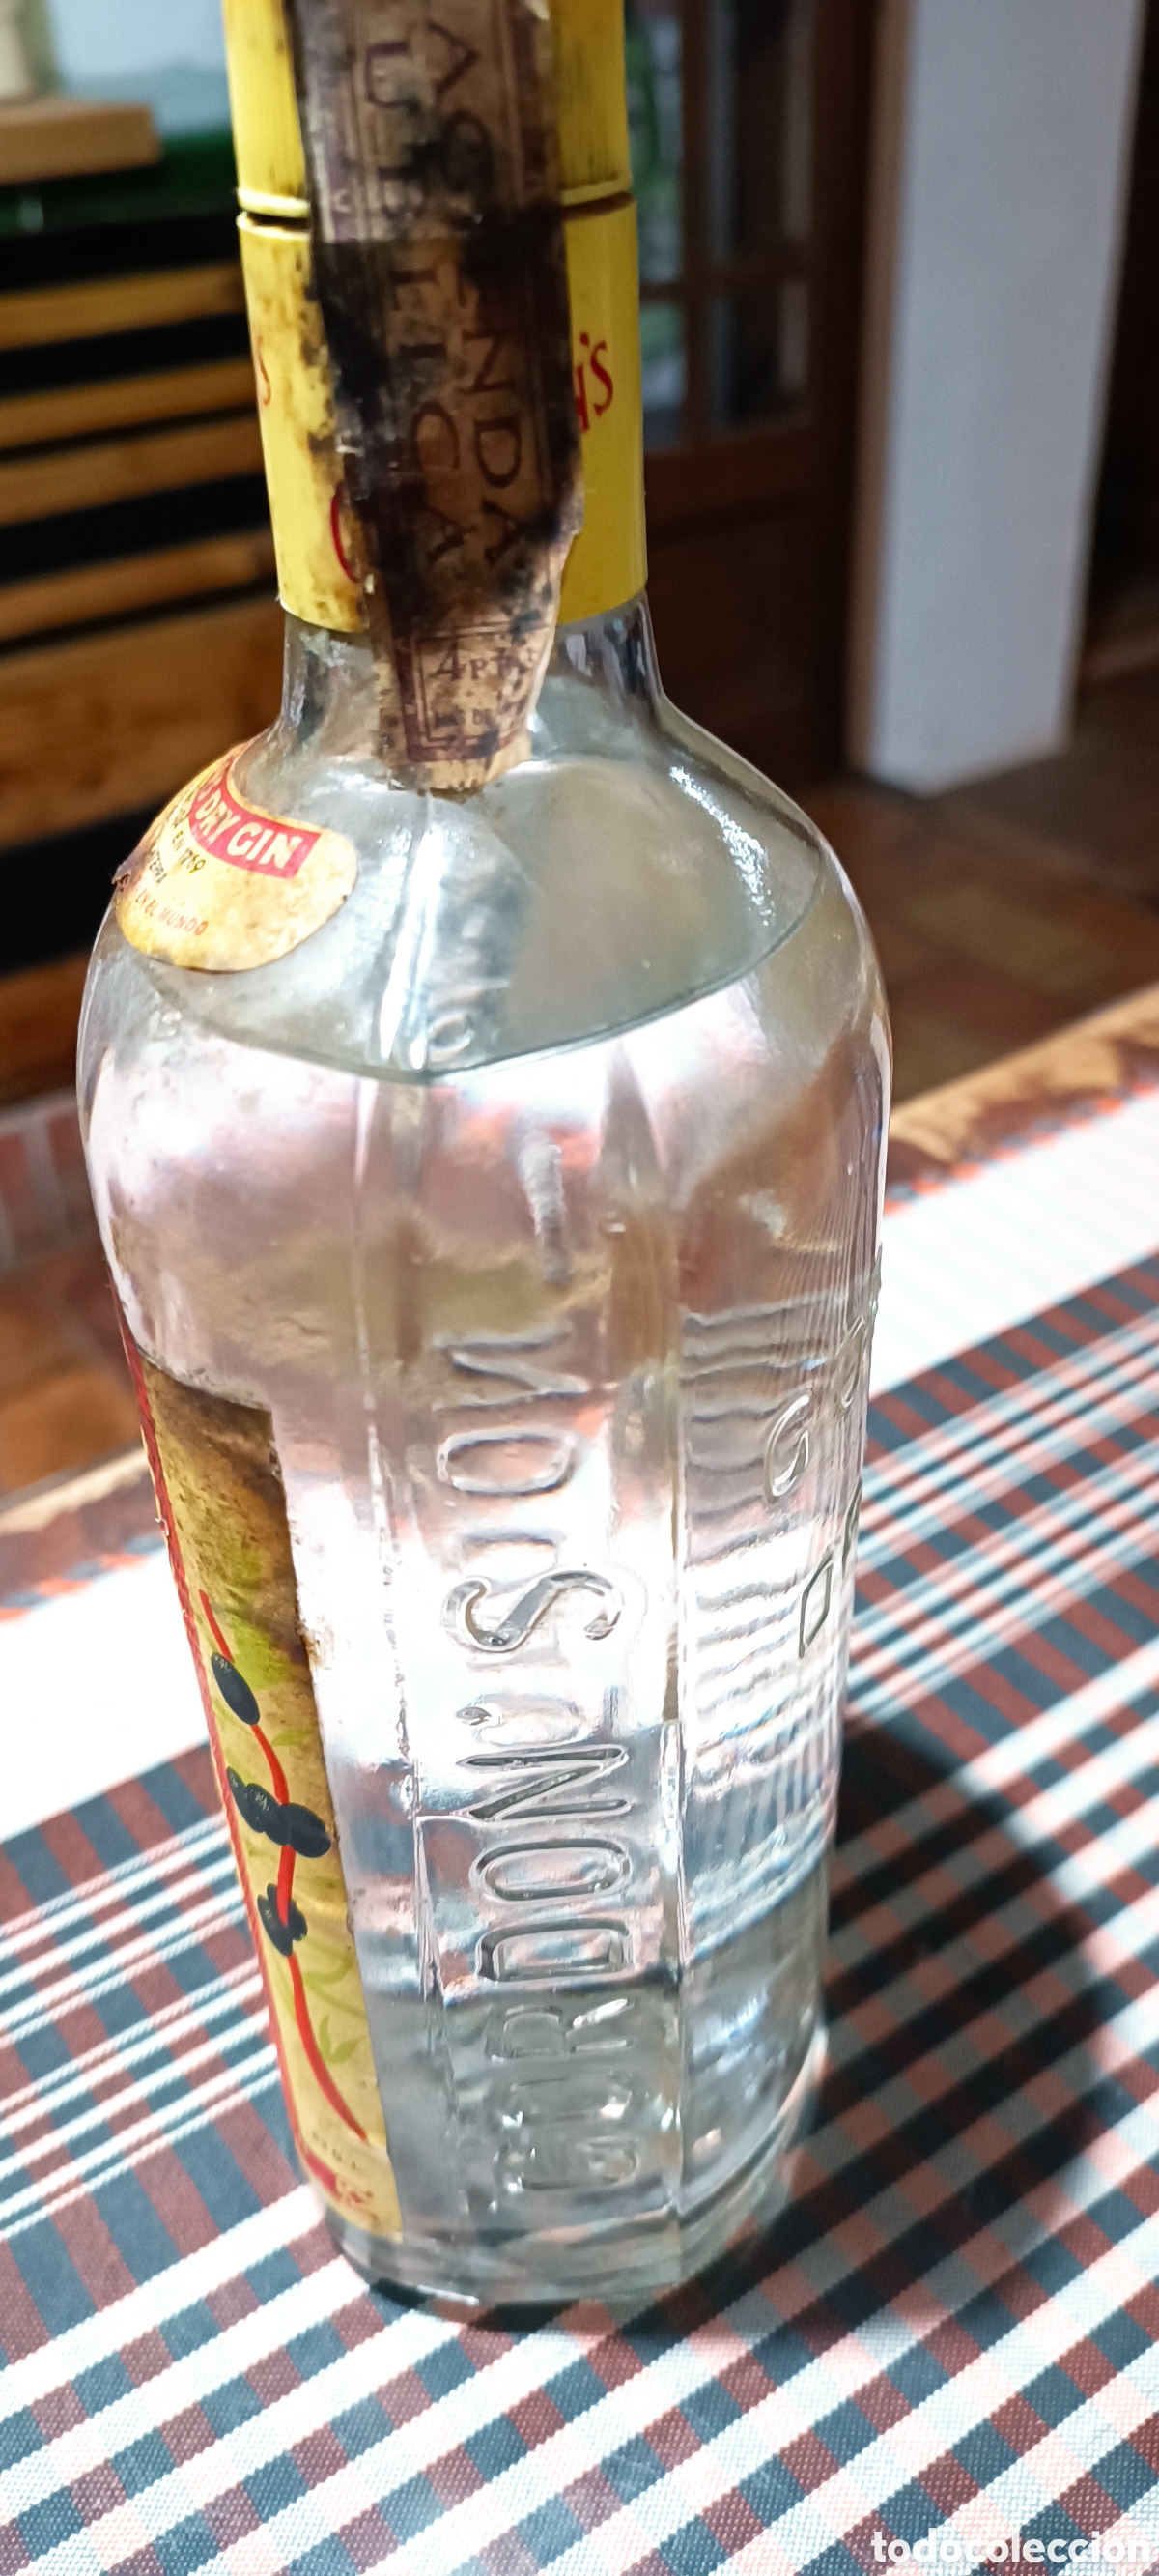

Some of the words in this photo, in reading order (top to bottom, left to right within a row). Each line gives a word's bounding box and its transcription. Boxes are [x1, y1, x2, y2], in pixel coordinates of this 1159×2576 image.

[194, 788, 241, 844] DRY
[226, 822, 303, 869] GIN
[158, 906, 209, 935] MUNDO
